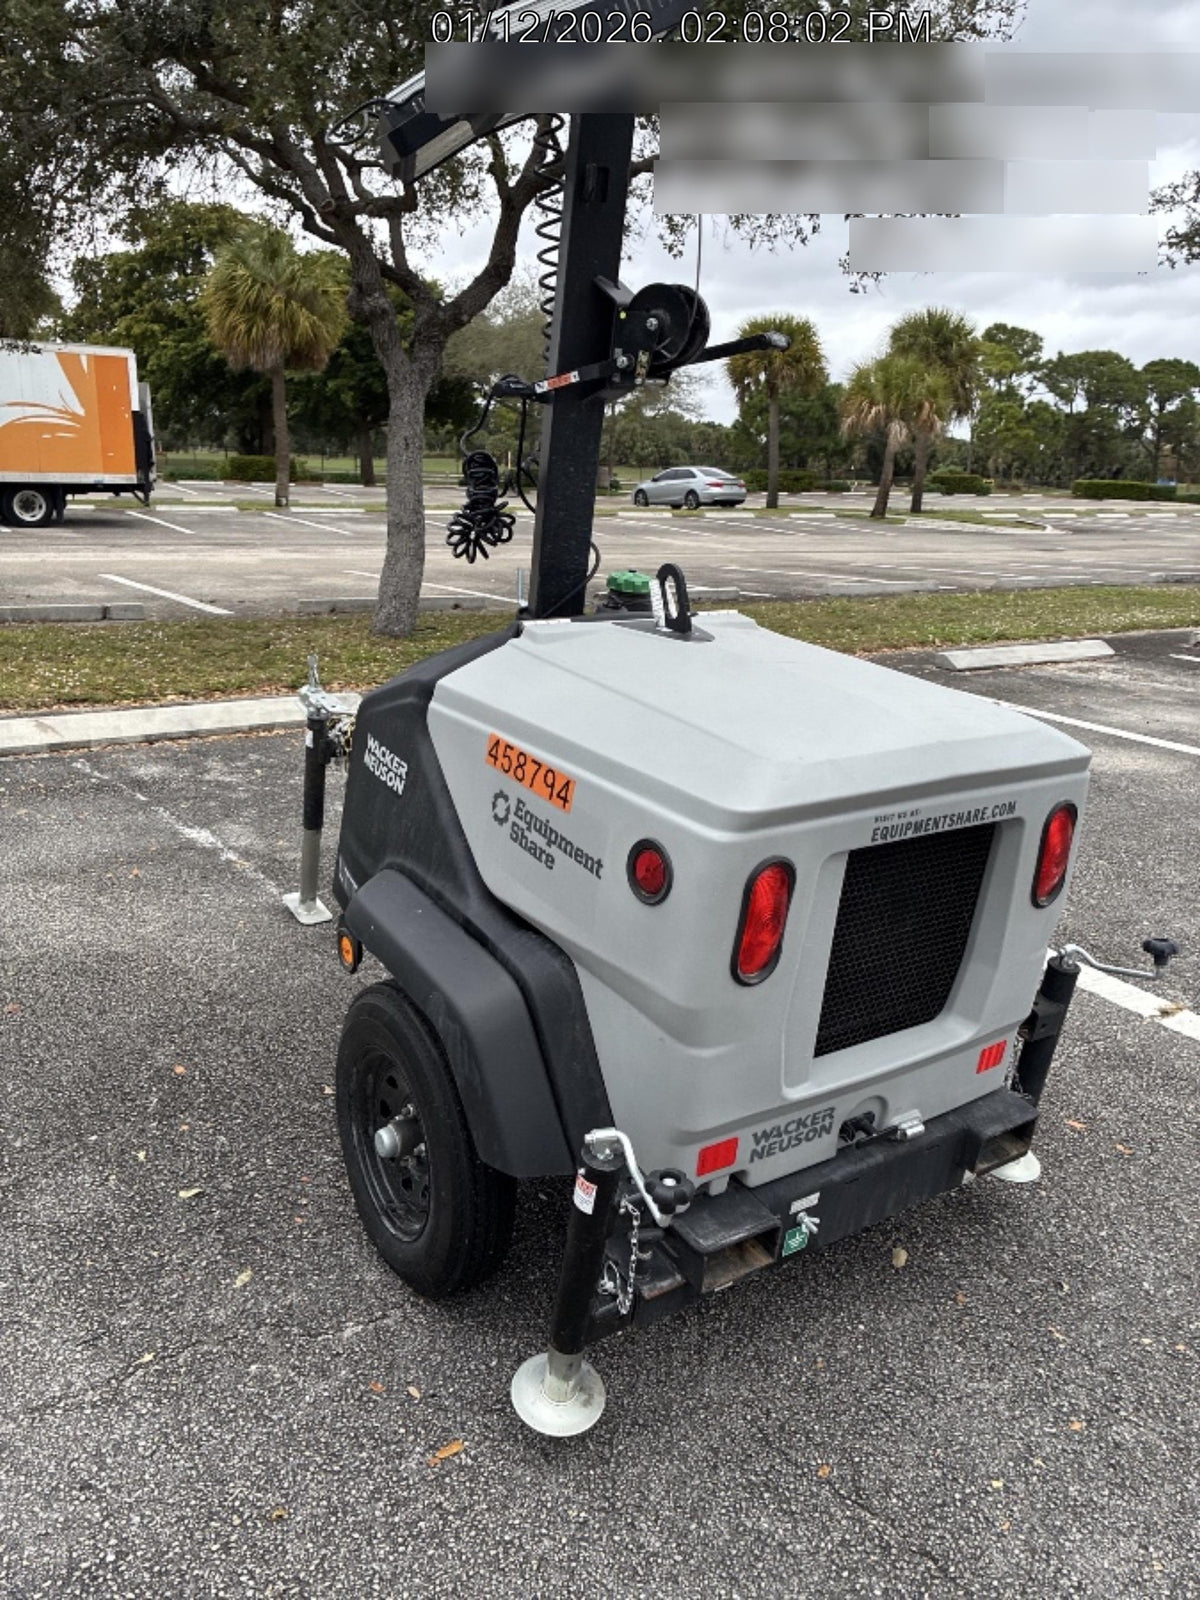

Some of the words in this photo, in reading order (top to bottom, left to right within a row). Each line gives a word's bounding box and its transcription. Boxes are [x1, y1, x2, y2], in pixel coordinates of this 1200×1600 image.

[363, 750, 405, 795] NEUSON
[366, 732, 408, 778] WACKER
[487, 738, 571, 809] 458794
[513, 797, 605, 880] Equipment
[871, 801, 1017, 843] EQUIPMENTSHARE.COM
[509, 823, 556, 870] Share
[748, 1121, 834, 1164] NEUSON
[751, 1106, 836, 1146] WACKER
